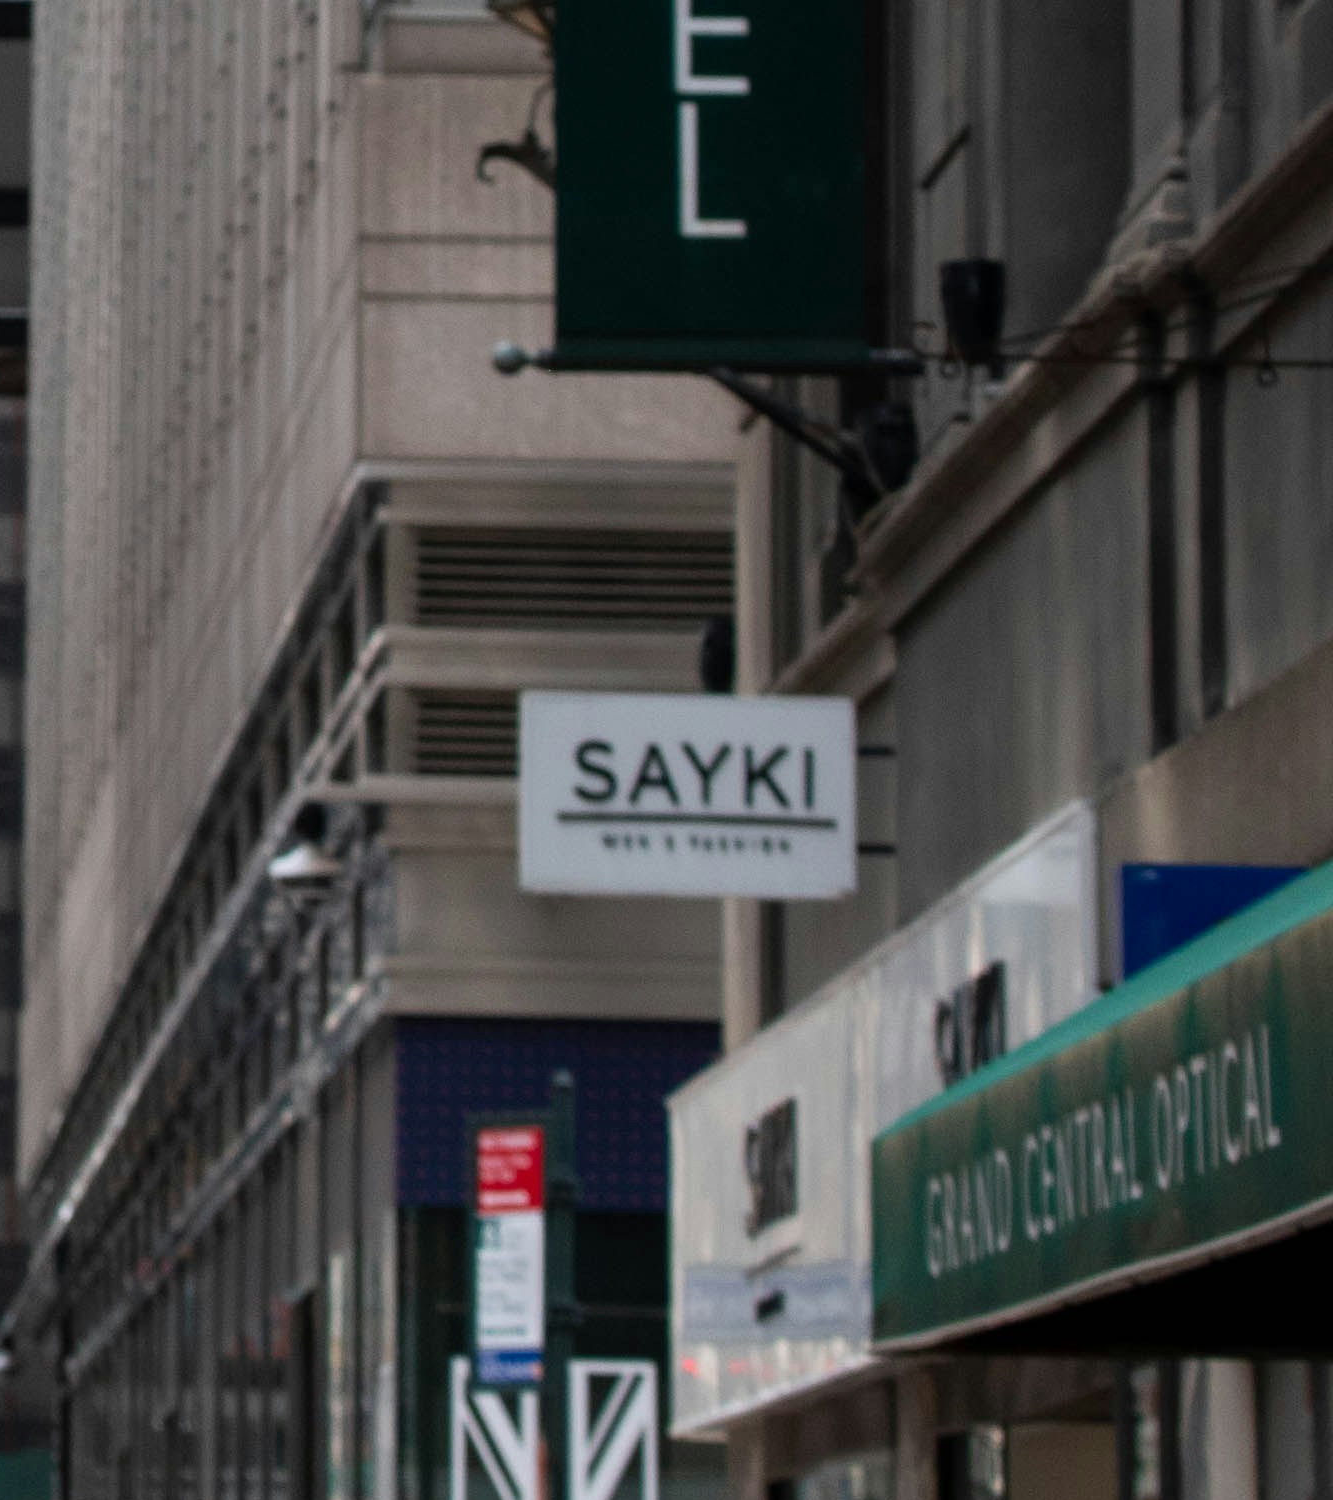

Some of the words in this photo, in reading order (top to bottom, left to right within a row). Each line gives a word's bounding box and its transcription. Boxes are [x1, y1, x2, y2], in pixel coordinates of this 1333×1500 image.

[573, 739, 817, 810] SAYKI
[926, 1148, 1013, 1280] GRAND
[1024, 1083, 1145, 1243] CENTRAL
[1152, 1022, 1282, 1191] OPTICAL
